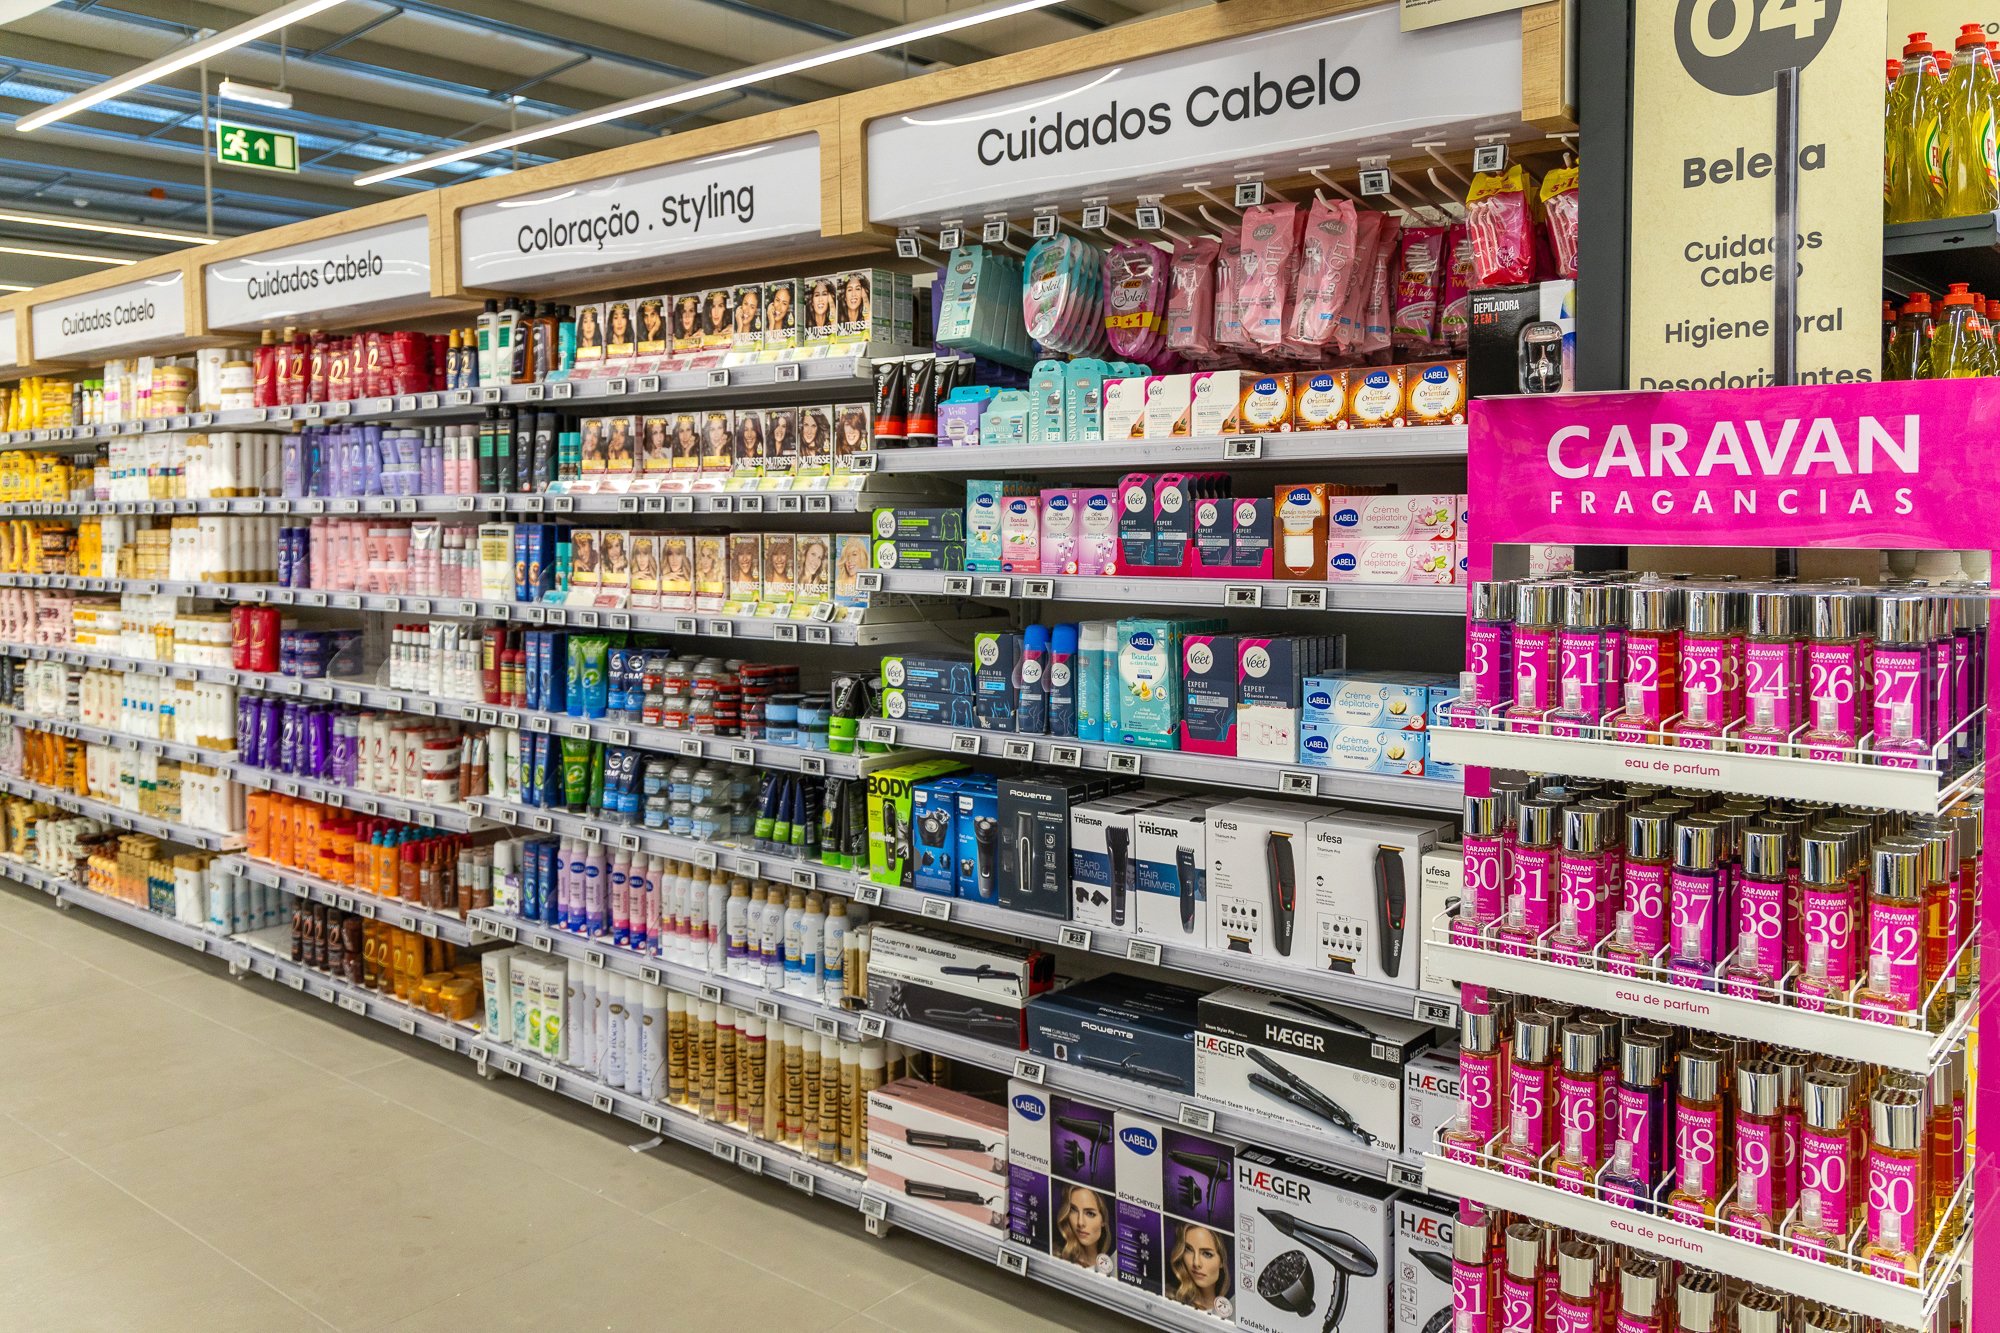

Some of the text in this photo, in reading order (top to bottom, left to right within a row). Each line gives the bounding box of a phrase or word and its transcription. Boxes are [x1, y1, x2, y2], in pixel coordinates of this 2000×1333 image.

[1690, 0, 1826, 57] 04
[977, 58, 1361, 163] Cuidados Cabelo
[1683, 143, 1826, 189] Belea
[518, 203, 639, 249] Coloração
[662, 183, 754, 232] Styling
[1254, 227, 1274, 237] LABELL
[1320, 220, 1344, 232] LABELL
[1684, 230, 1823, 263] Cuidaos
[956, 262, 974, 273] LABELL
[1700, 262, 1804, 287] Cabeo
[247, 250, 383, 301] Cuidados Cabelo
[1406, 274, 1425, 282] BIC
[1474, 299, 1519, 314] DEPILADORA
[62, 300, 155, 336] Cuidados Cabelo
[1112, 318, 1119, 326] 3
[1136, 314, 1144, 326] 1
[1474, 313, 1499, 324] 2 EM 1
[837, 320, 870, 334] NUTRISSE
[1665, 308, 1843, 348] Higiene ral
[1364, 376, 1390, 385] LABELL
[1424, 369, 1449, 380] LABELL
[1150, 387, 1163, 396] Veet
[1254, 383, 1275, 391] LABELL
[1310, 380, 1333, 388] LABELL
[1547, 414, 1920, 478] CARAVAN
[976, 496, 993, 505] LABELL
[1050, 498, 1068, 507] LABELL
[1127, 496, 1143, 505] Veet
[1162, 496, 1180, 505] Veet
[1289, 492, 1311, 501] LABELL
[1550, 488, 1914, 515] FRAGANCIAS
[1373, 505, 1400, 514] Crème
[1334, 513, 1358, 522] LABELL
[1366, 513, 1408, 523] dépilatoire
[1332, 558, 1356, 567] LABELL
[1371, 551, 1398, 560] Crème
[1364, 558, 1407, 569] dépilatoire
[1131, 637, 1154, 647] LABELL
[979, 644, 996, 656] Veet
[1131, 653, 1157, 662] Bandes
[1684, 645, 1721, 655] CARAVAN
[1747, 649, 1784, 658] CARAVAN
[1811, 652, 1850, 661] CARAVAN
[1190, 652, 1211, 665] Veet
[1246, 655, 1268, 669] Veet
[1471, 642, 1489, 676] 3
[1517, 651, 1537, 681] 5
[1876, 657, 1915, 667] CARAVAN
[1683, 656, 1723, 696] 23
[1746, 661, 1790, 700] 24
[1187, 680, 1208, 689] EXPERT
[1809, 664, 1854, 704] 26
[1874, 671, 1920, 710] 27
[1308, 695, 1331, 706] LABELL
[1345, 690, 1372, 701] Crème
[1339, 698, 1380, 710] dépilatoire
[1625, 758, 1721, 779] eau de parfum
[867, 775, 912, 800] BODY
[1215, 819, 1238, 832] ufesa
[1317, 832, 1342, 845] ufesa
[1465, 845, 1498, 855] CARAVAN
[1074, 859, 1100, 871] BEARD
[1425, 864, 1451, 878] ufesa
[1464, 855, 1500, 890] 30
[1625, 867, 1659, 878] CARAVAN
[1074, 867, 1108, 882] TRIMMER
[1140, 870, 1160, 880] HAIR
[1140, 878, 1176, 893] TRIMMER
[1674, 878, 1710, 890] CARAVAN
[1742, 885, 1779, 897] CARAVAN
[1560, 873, 1596, 911] 35
[1624, 879, 1663, 919] 36
[1672, 890, 1712, 928] 37
[1874, 909, 1915, 921] CARAVAN
[1740, 897, 1782, 939] 38
[1806, 909, 1854, 950] 39
[1870, 926, 1918, 966] 42
[1616, 989, 1710, 1016] eau de parfum
[1433, 1007, 1445, 1018] 38
[1265, 1023, 1325, 1053] HÆGER
[1196, 1034, 1246, 1059] HÆGER
[1408, 1070, 1460, 1097] HÆGE
[1460, 1074, 1492, 1109] 43
[1013, 1098, 1043, 1118] LABELL
[1197, 1092, 1227, 1106] Professional
[1227, 1099, 1243, 1110] Steam
[1243, 1103, 1256, 1113] Hair
[1256, 1106, 1286, 1122] Straightner
[1560, 1094, 1595, 1133] 46
[1678, 1109, 1711, 1124] CARAVAN
[1123, 1131, 1155, 1152] LABELL
[1376, 1138, 1396, 1151] 230W
[1676, 1124, 1714, 1166] 48
[1805, 1136, 1843, 1150] CARAVAN
[1010, 1147, 1049, 1167] SÈCHE-CHEVEUX
[1871, 1156, 1912, 1172] CARAVAN
[1407, 1172, 1416, 1182] 19
[1802, 1150, 1846, 1194] 50
[1239, 1165, 1312, 1205] HÆGER
[1239, 1184, 1279, 1201] Perfect Fold 2000
[1868, 1169, 1915, 1217] 80
[1118, 1191, 1162, 1211] SÈCHE-CHEVEUX
[1400, 1210, 1453, 1244] HÆG
[1400, 1230, 1440, 1248] Pro Hair 2300
[1610, 1219, 1704, 1254] eau de parfum
[1121, 1272, 1143, 1287] 2200 W
[1453, 1278, 1487, 1316] 81
[1240, 1317, 1270, 1333] Foldable
